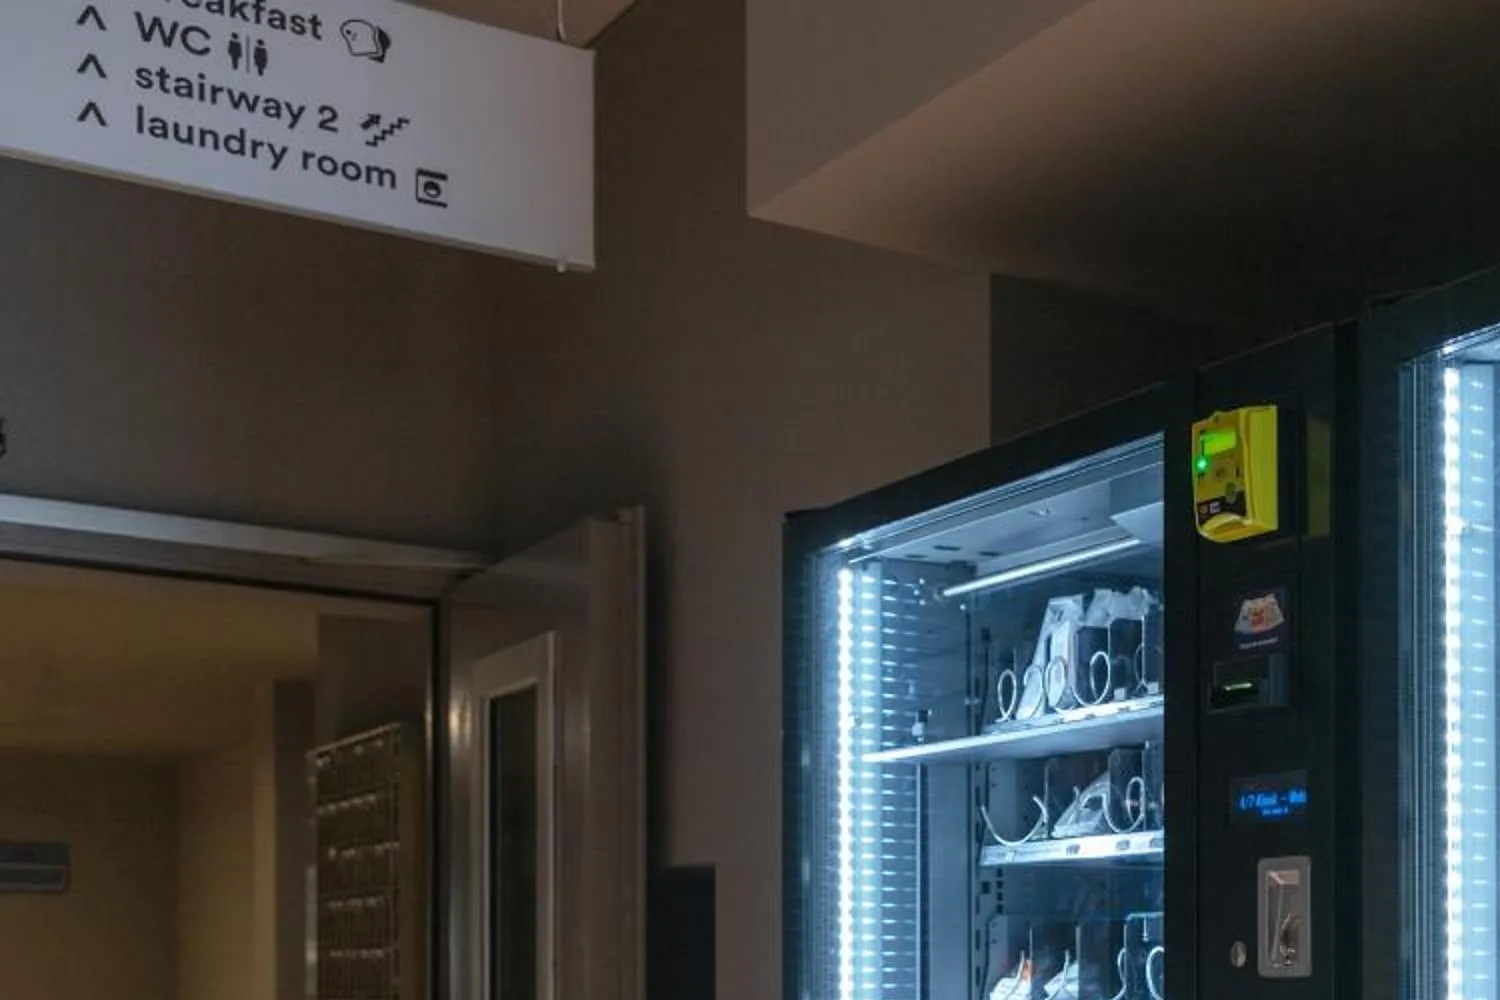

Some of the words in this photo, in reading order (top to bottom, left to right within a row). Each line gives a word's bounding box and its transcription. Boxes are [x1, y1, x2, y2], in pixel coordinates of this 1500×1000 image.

[135, 11, 211, 56] WC
[166, 0, 323, 41] akfast
[135, 66, 306, 129] stairway
[317, 105, 339, 134] 2
[136, 104, 289, 170] laundry
[302, 150, 397, 189] room
